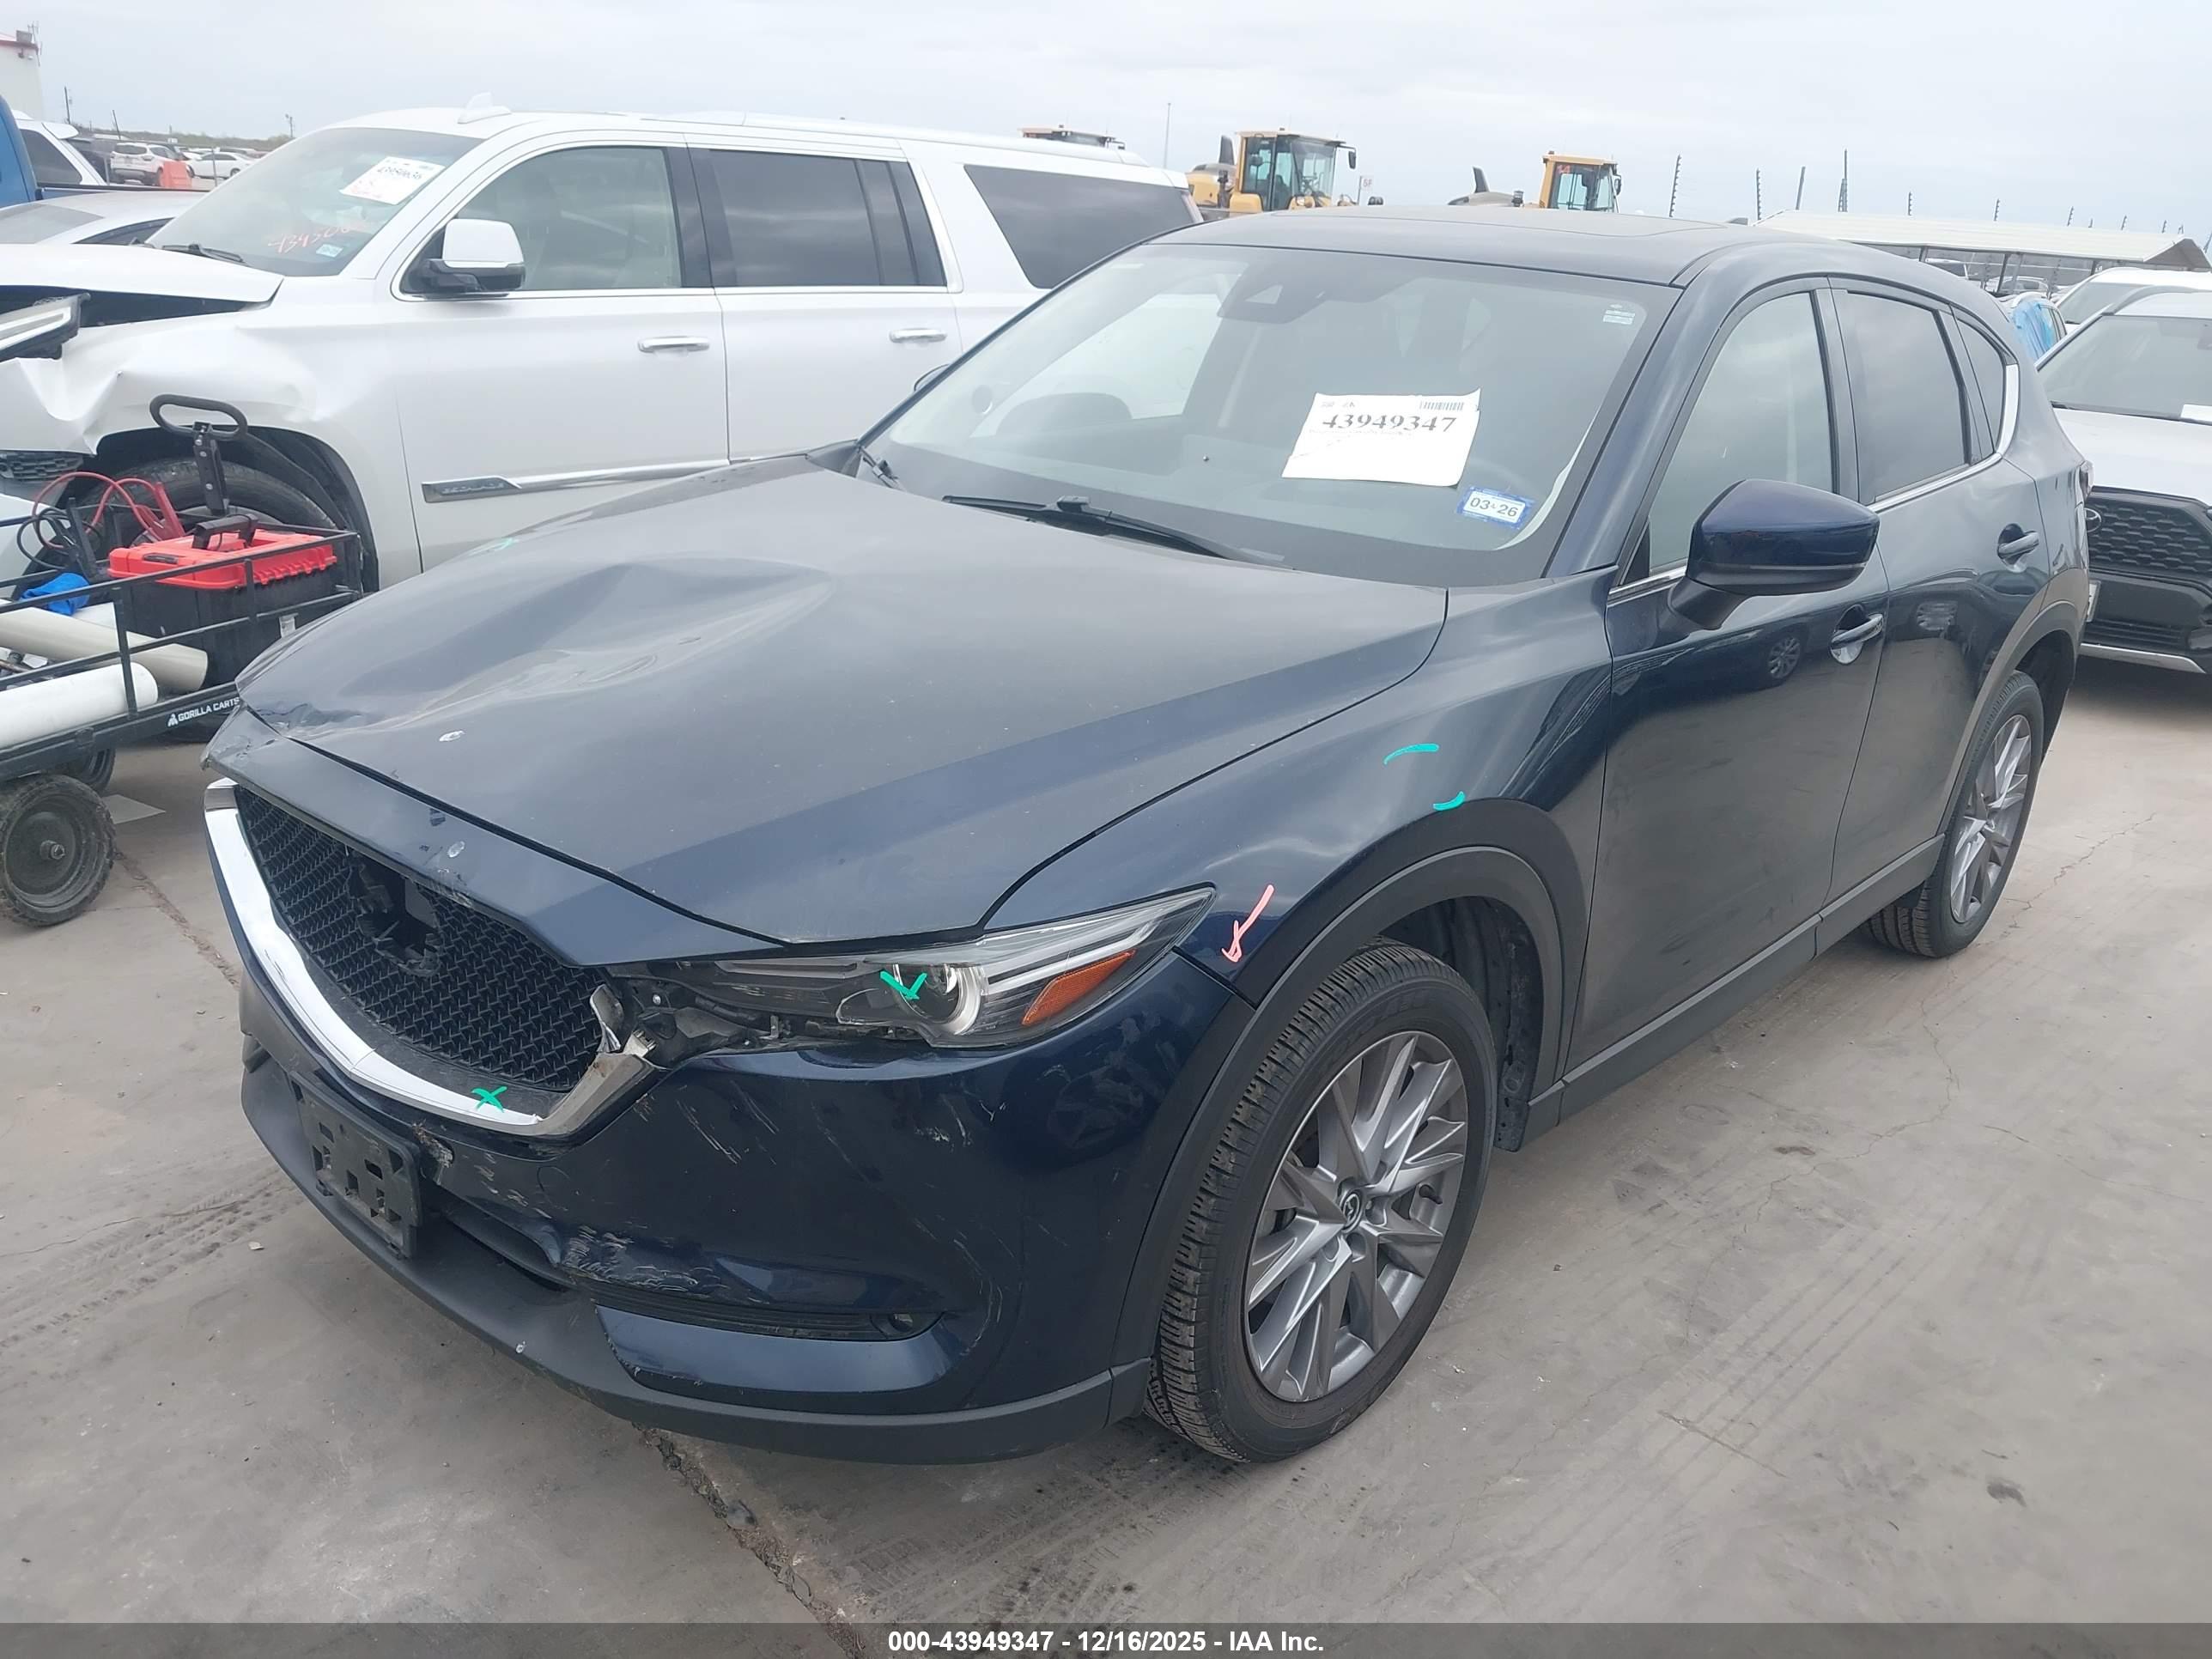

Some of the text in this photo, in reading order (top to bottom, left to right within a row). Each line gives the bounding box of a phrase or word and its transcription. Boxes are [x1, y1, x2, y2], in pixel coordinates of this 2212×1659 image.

[1322, 414, 1457, 433] 43949347
[1470, 497, 1519, 517] 03 26
[177, 696, 240, 722] GORILLA CARTS
